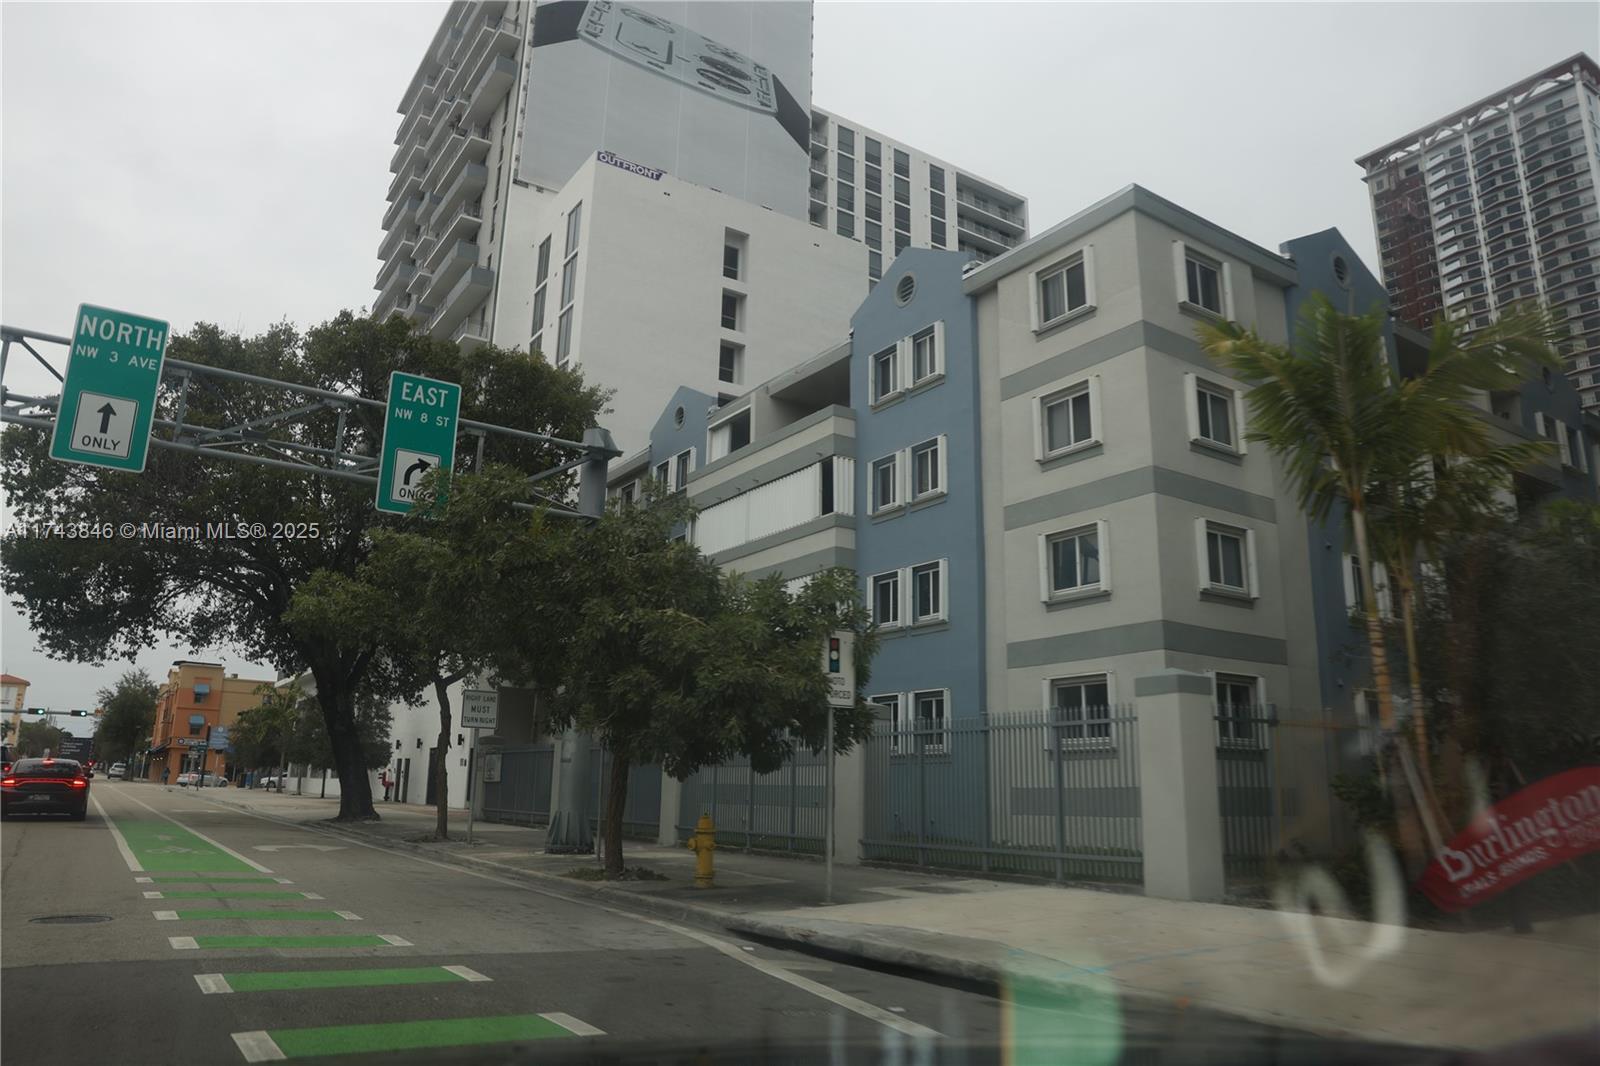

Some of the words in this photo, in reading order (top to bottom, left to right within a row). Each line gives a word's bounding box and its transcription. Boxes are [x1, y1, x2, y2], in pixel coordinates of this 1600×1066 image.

[600, 153, 659, 179] OUTFRONT
[80, 315, 162, 351] NORTH
[76, 343, 98, 359] NW
[109, 350, 118, 363] 3
[128, 356, 157, 371] AVE
[402, 382, 448, 408] EAST
[395, 407, 413, 420] NW
[420, 412, 428, 423] 8
[435, 416, 450, 427] ST
[81, 435, 120, 452] ONLY
[399, 487, 434, 500] ON
[471, 705, 490, 713] MUST
